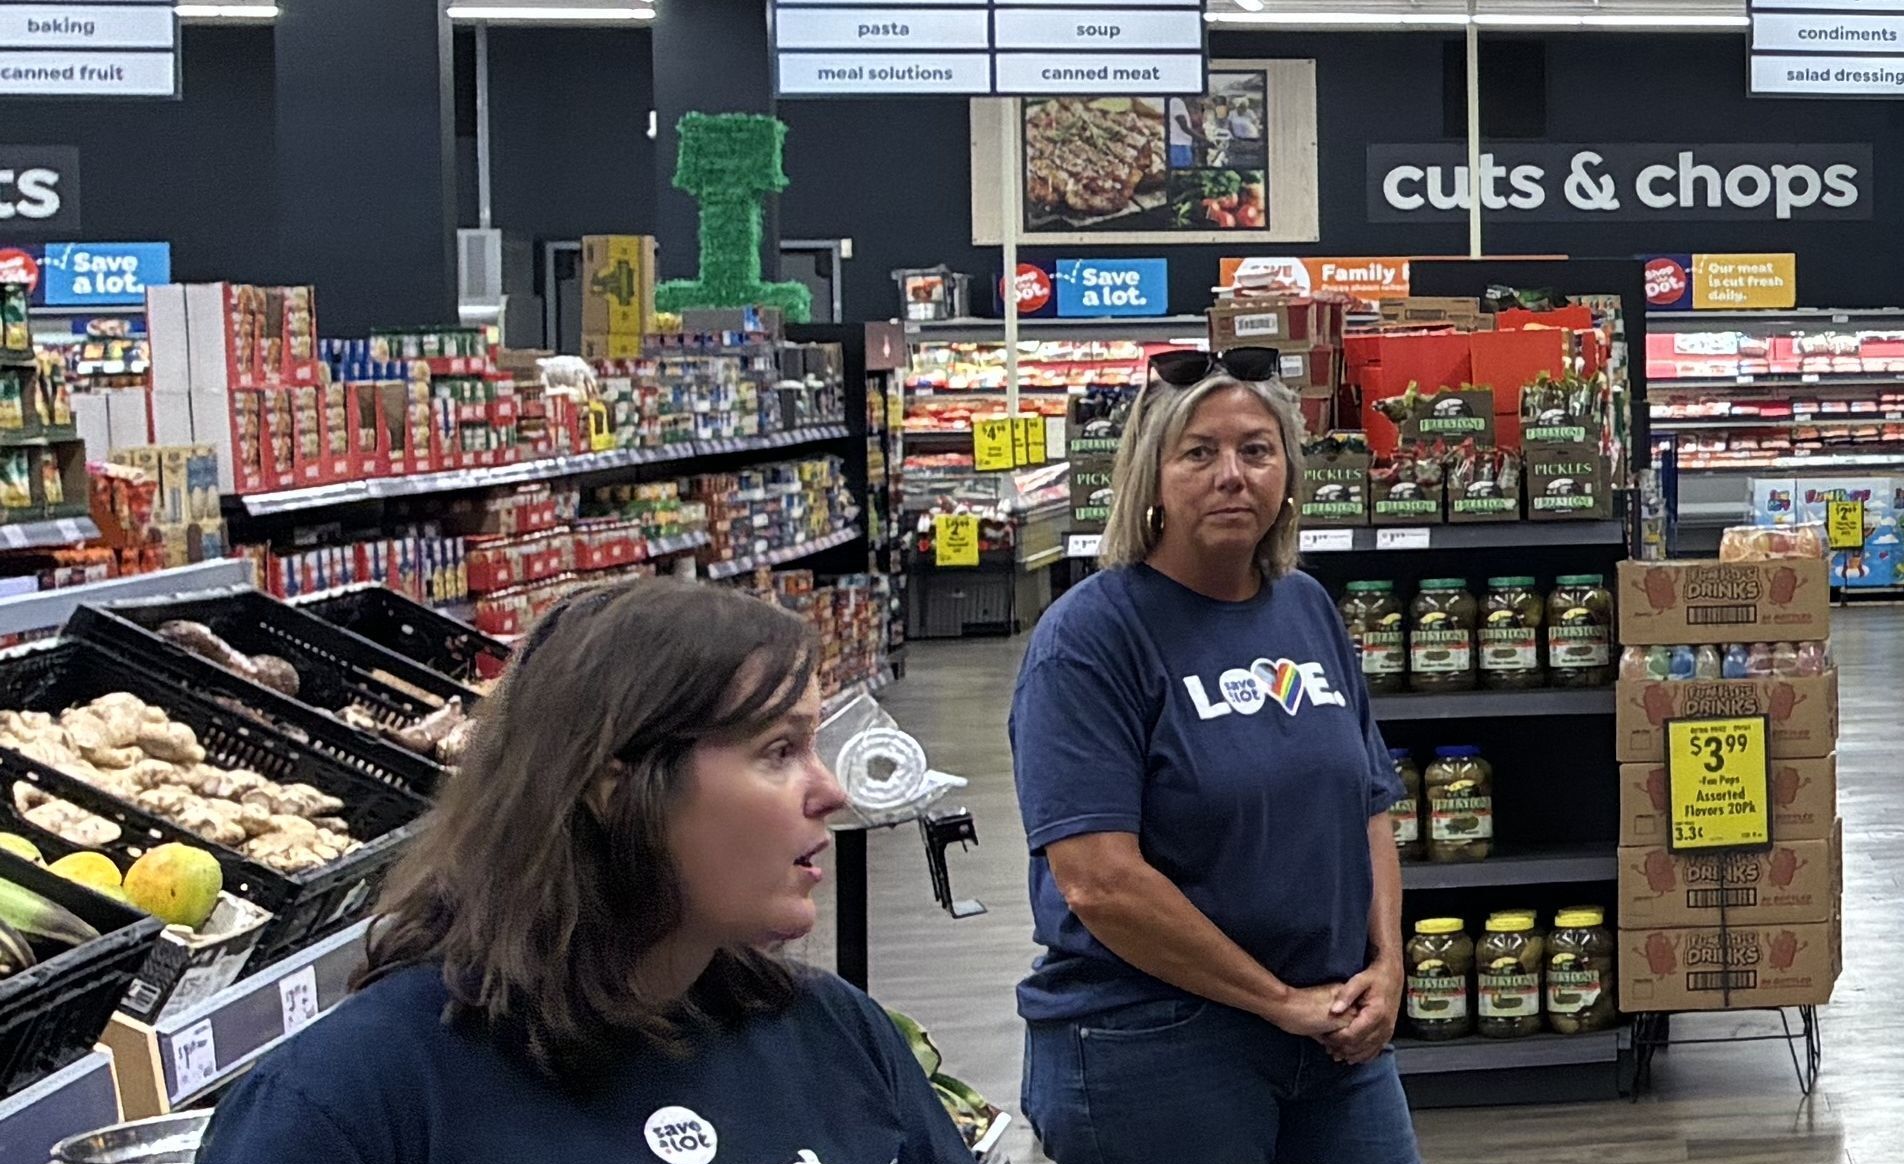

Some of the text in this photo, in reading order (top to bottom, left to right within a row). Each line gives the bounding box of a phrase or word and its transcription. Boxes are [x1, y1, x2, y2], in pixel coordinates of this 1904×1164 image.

[27, 17, 95, 35] baking
[857, 23, 910, 38] pasta
[1076, 24, 1121, 39] soup
[1797, 26, 1897, 42] condiments
[1, 64, 124, 81] canned fruit
[817, 65, 953, 81] meal solutions
[1041, 65, 1161, 81] canned meat
[1786, 68, 1831, 84] salad
[1383, 151, 1859, 219] cuts & chops
[72, 252, 139, 273] Save
[1708, 262, 1774, 274] Our meat
[1083, 267, 1140, 287] Save
[1321, 263, 1396, 283] Family
[1708, 274, 1784, 288] is cut fresh
[1083, 285, 1148, 307] a lot.
[1708, 289, 1748, 302] daily.
[1534, 463, 1593, 475] PICKLES
[1077, 473, 1113, 486] PICK
[1687, 581, 1760, 600] DRINKS
[1685, 699, 1759, 716] DRINKS
[1690, 734, 1748, 772] $399
[1696, 789, 1746, 802] Assorted
[1684, 804, 1725, 817] Flavors
[653, 1120, 702, 1139] save
